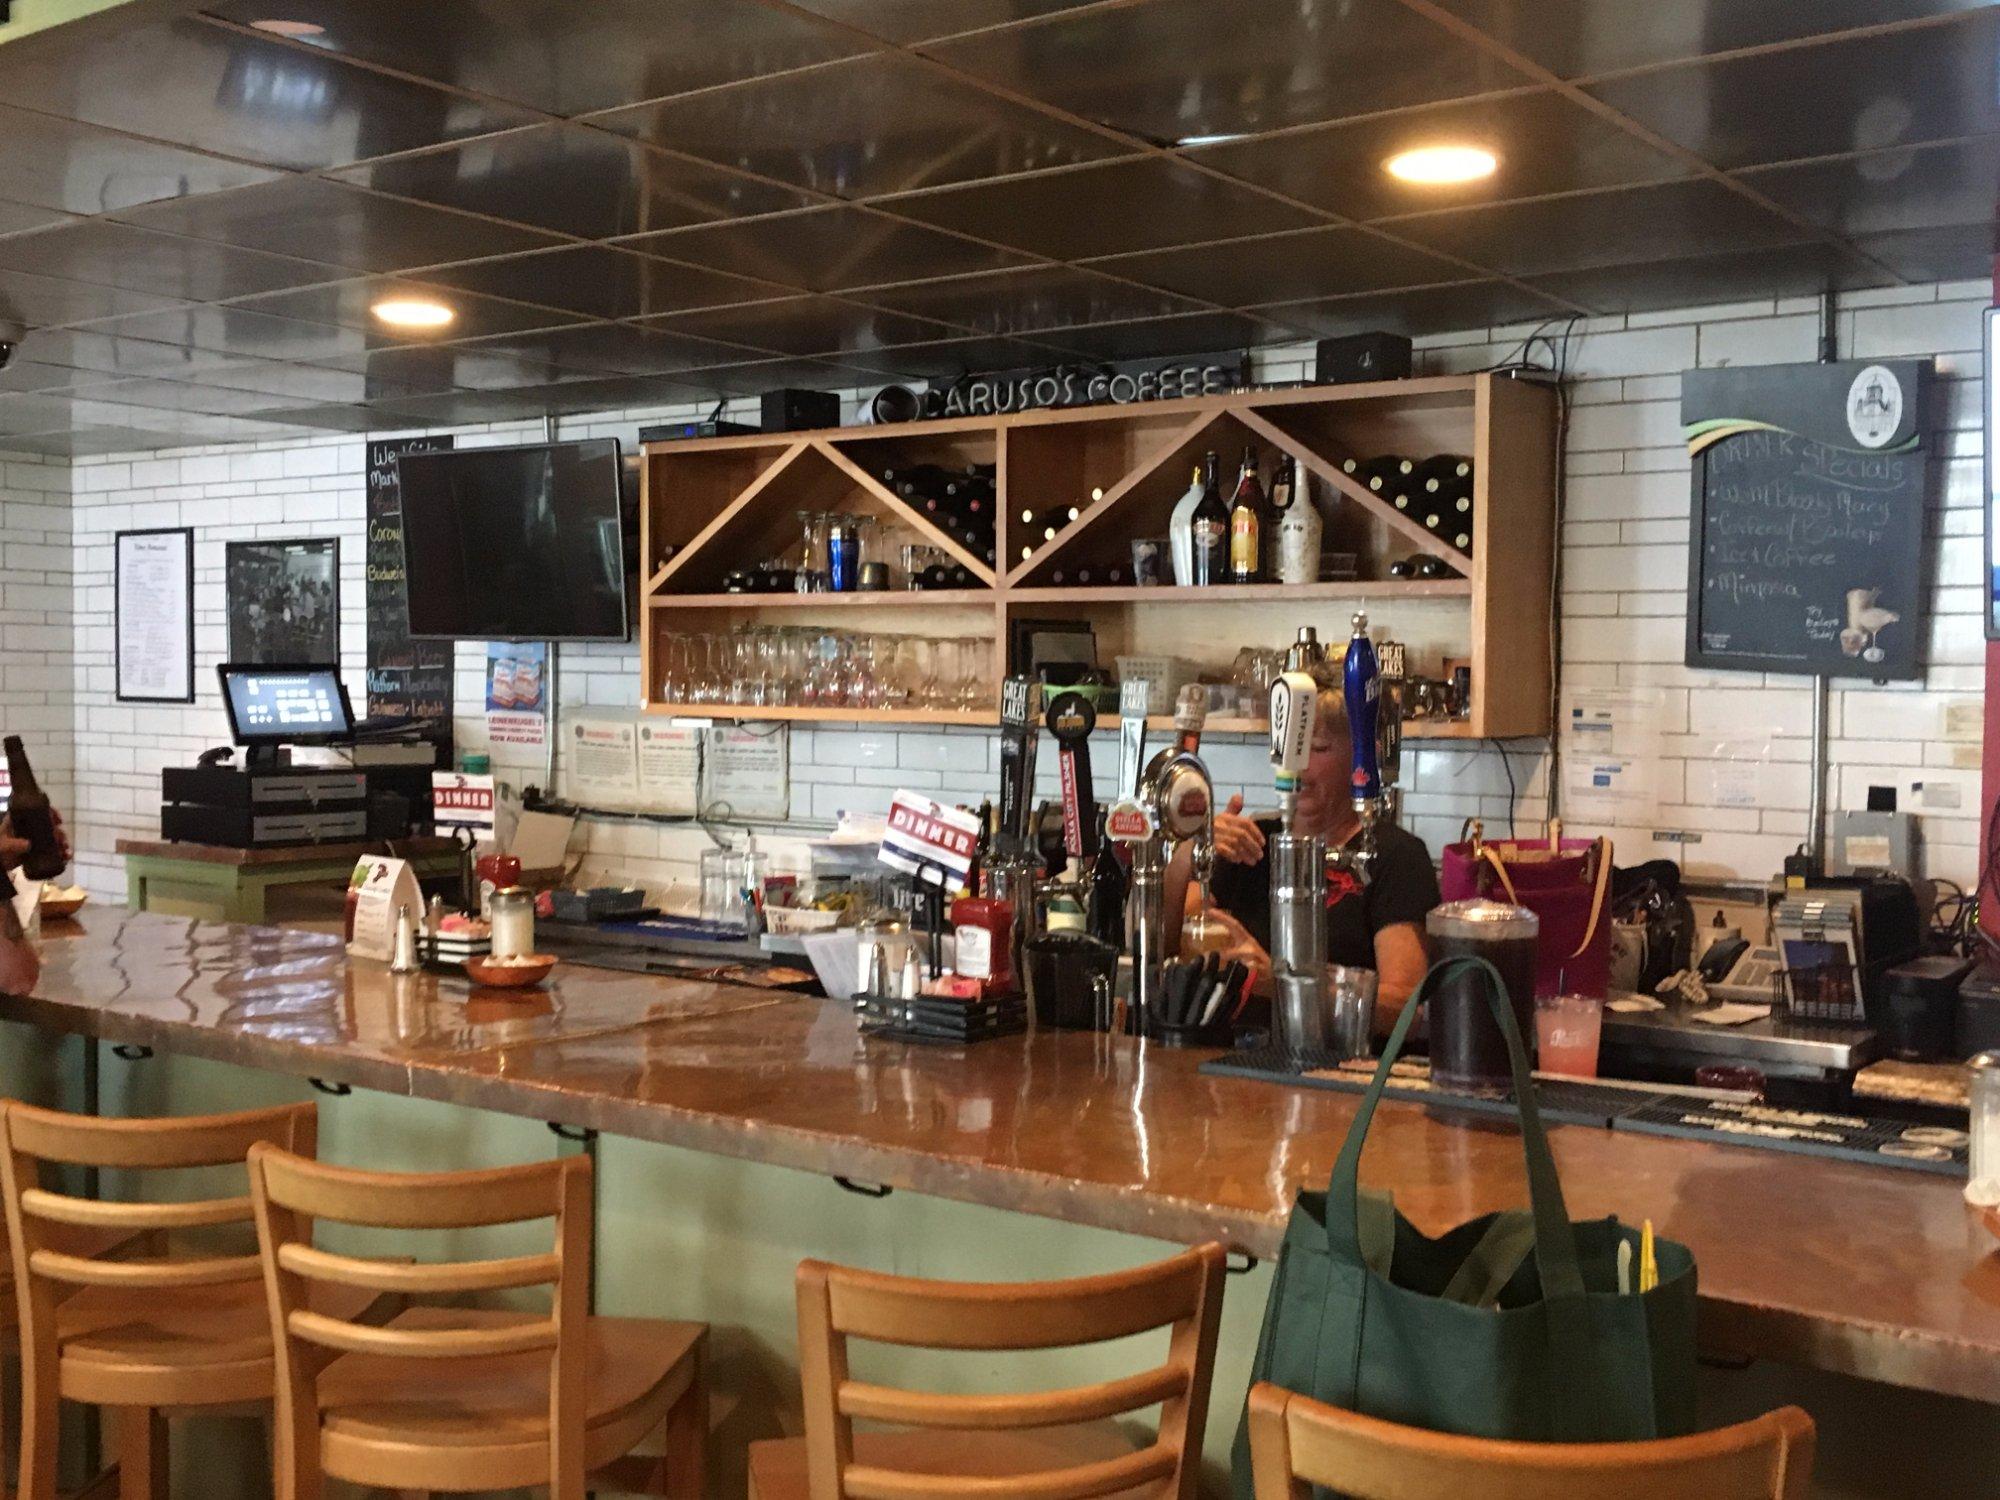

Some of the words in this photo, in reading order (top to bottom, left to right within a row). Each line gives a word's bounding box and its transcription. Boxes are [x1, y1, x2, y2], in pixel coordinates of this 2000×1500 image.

[926, 365, 1076, 417] CARUSO'S
[1088, 366, 1222, 405] COFFEE
[1378, 644, 1405, 661] GREAT
[1379, 660, 1404, 676] LAKES
[1003, 680, 1028, 701] GREAT
[1122, 680, 1147, 696] GREAT
[1002, 700, 1026, 721] LAKES
[1122, 695, 1146, 710] LAKES
[1295, 694, 1310, 757] PLATFORM
[434, 790, 490, 807] DINNER
[893, 809, 970, 853] DINNER
